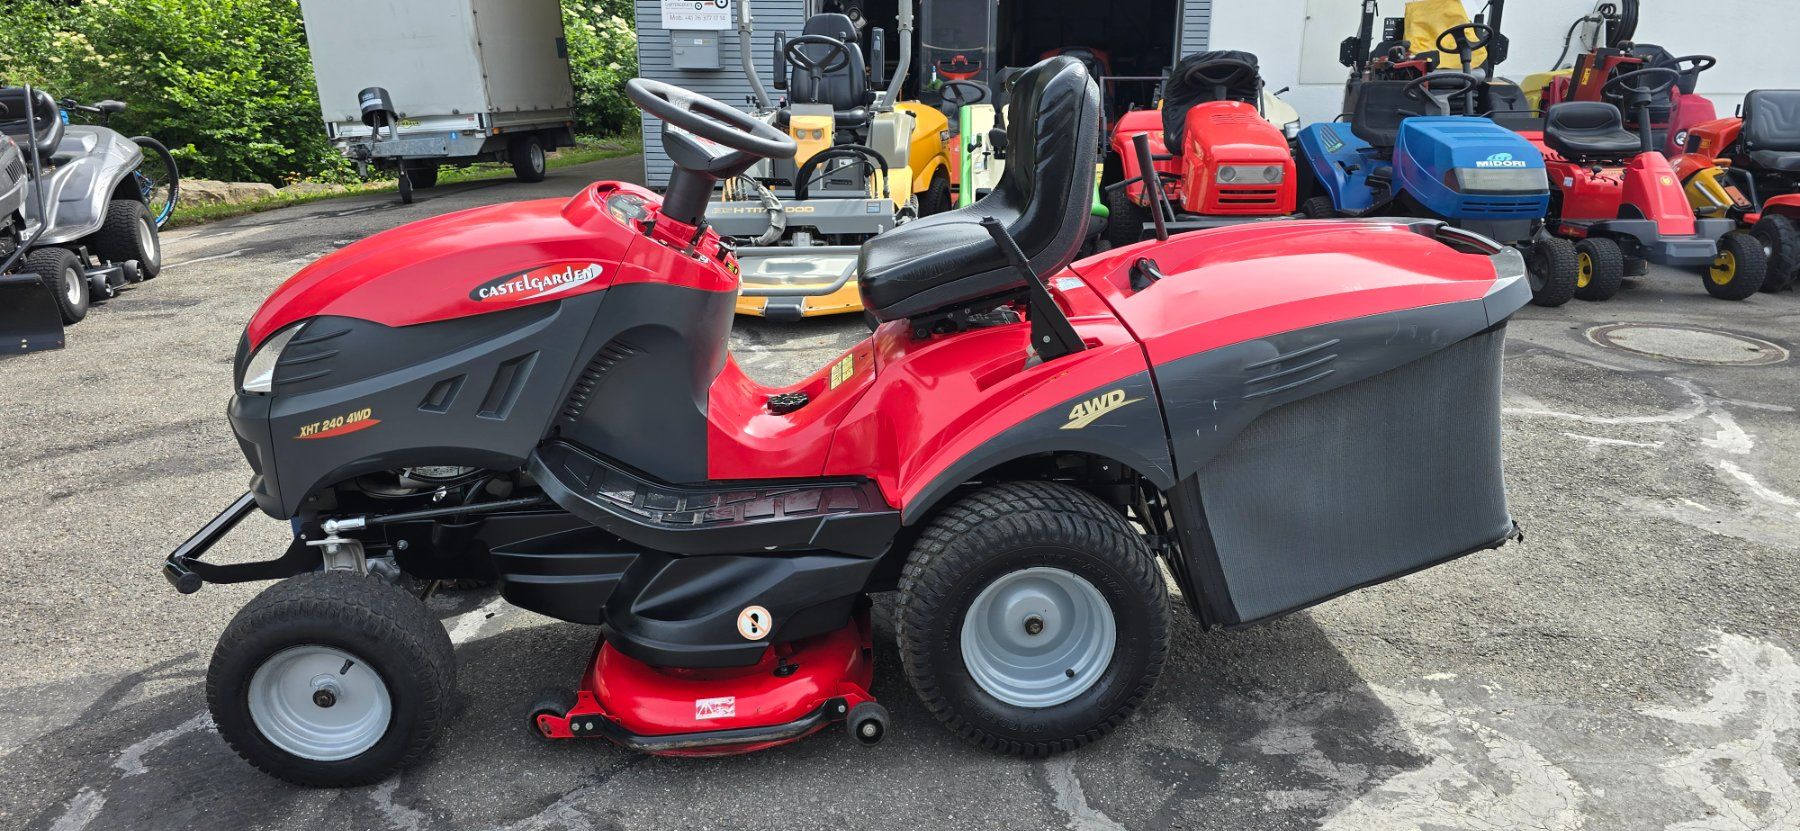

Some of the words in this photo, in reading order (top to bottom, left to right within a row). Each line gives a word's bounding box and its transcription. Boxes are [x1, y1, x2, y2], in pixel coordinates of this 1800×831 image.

[1476, 160, 1527, 168] MIDORI
[479, 265, 595, 299] CASTELGARDEN
[1068, 389, 1126, 421] 4WD
[299, 422, 320, 438] XHT
[321, 416, 344, 432] 240
[346, 408, 372, 424] 4WD
